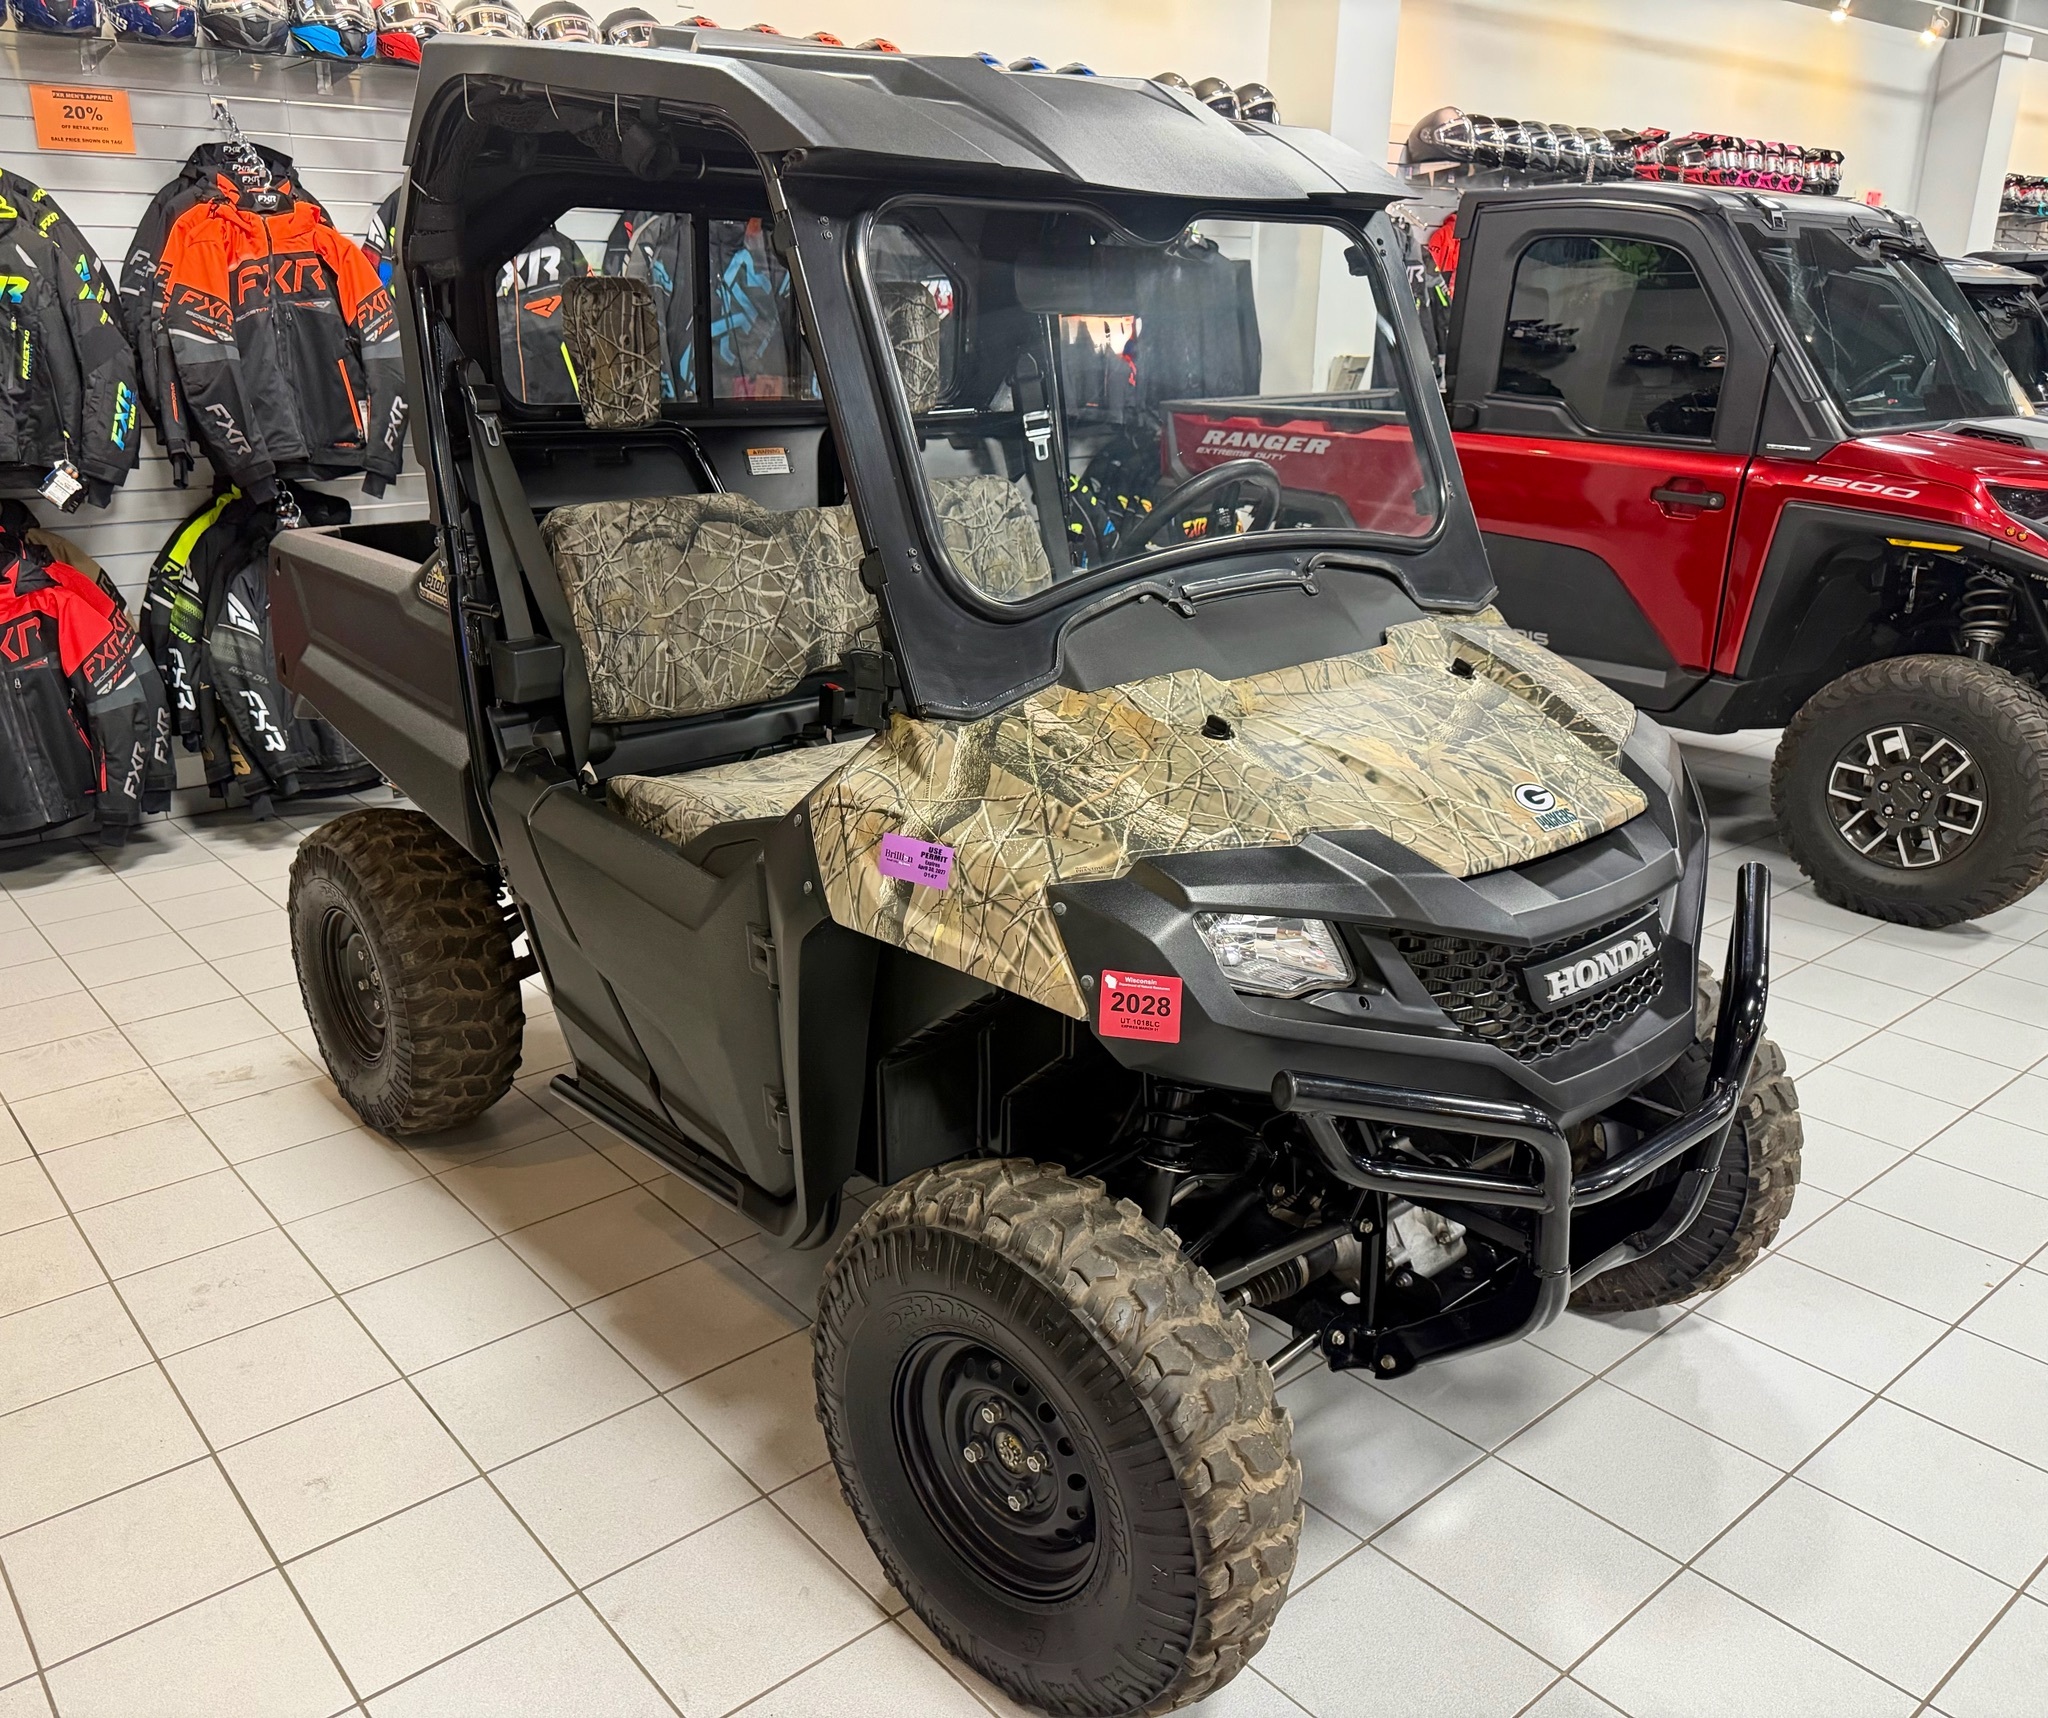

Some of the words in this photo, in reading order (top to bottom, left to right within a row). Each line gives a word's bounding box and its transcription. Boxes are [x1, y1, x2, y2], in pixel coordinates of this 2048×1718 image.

[66, 92, 85, 100] MEN'S
[85, 93, 113, 102] APPAREL
[63, 105, 103, 121] 20%
[258, 195, 277, 203] FXR
[238, 258, 327, 307] FXR
[496, 246, 561, 297] XR
[357, 289, 393, 329] FXR
[111, 381, 132, 451] FXR
[205, 403, 252, 456] FXR
[384, 395, 409, 452] FXR
[1196, 446, 1252, 458] EXTREME
[1254, 451, 1287, 461] DUTY
[1202, 430, 1331, 455] RANGER
[1802, 474, 1920, 499] 1500
[82, 632, 125, 684] FXR
[168, 648, 196, 711] FXR
[239, 690, 286, 752] FXR
[154, 707, 171, 764] FXR
[123, 741, 146, 800] FXR
[1514, 783, 1556, 812] G
[1535, 807, 1578, 830] PACKERS
[920, 851, 948, 863] PERMIT
[928, 846, 943, 855] USE
[923, 872, 938, 880] 0147
[1544, 931, 1656, 1001] HONDA
[1124, 976, 1158, 985] Wisconsin
[1110, 991, 1171, 1017] 2028
[1133, 1018, 1160, 1028] 1018LC
